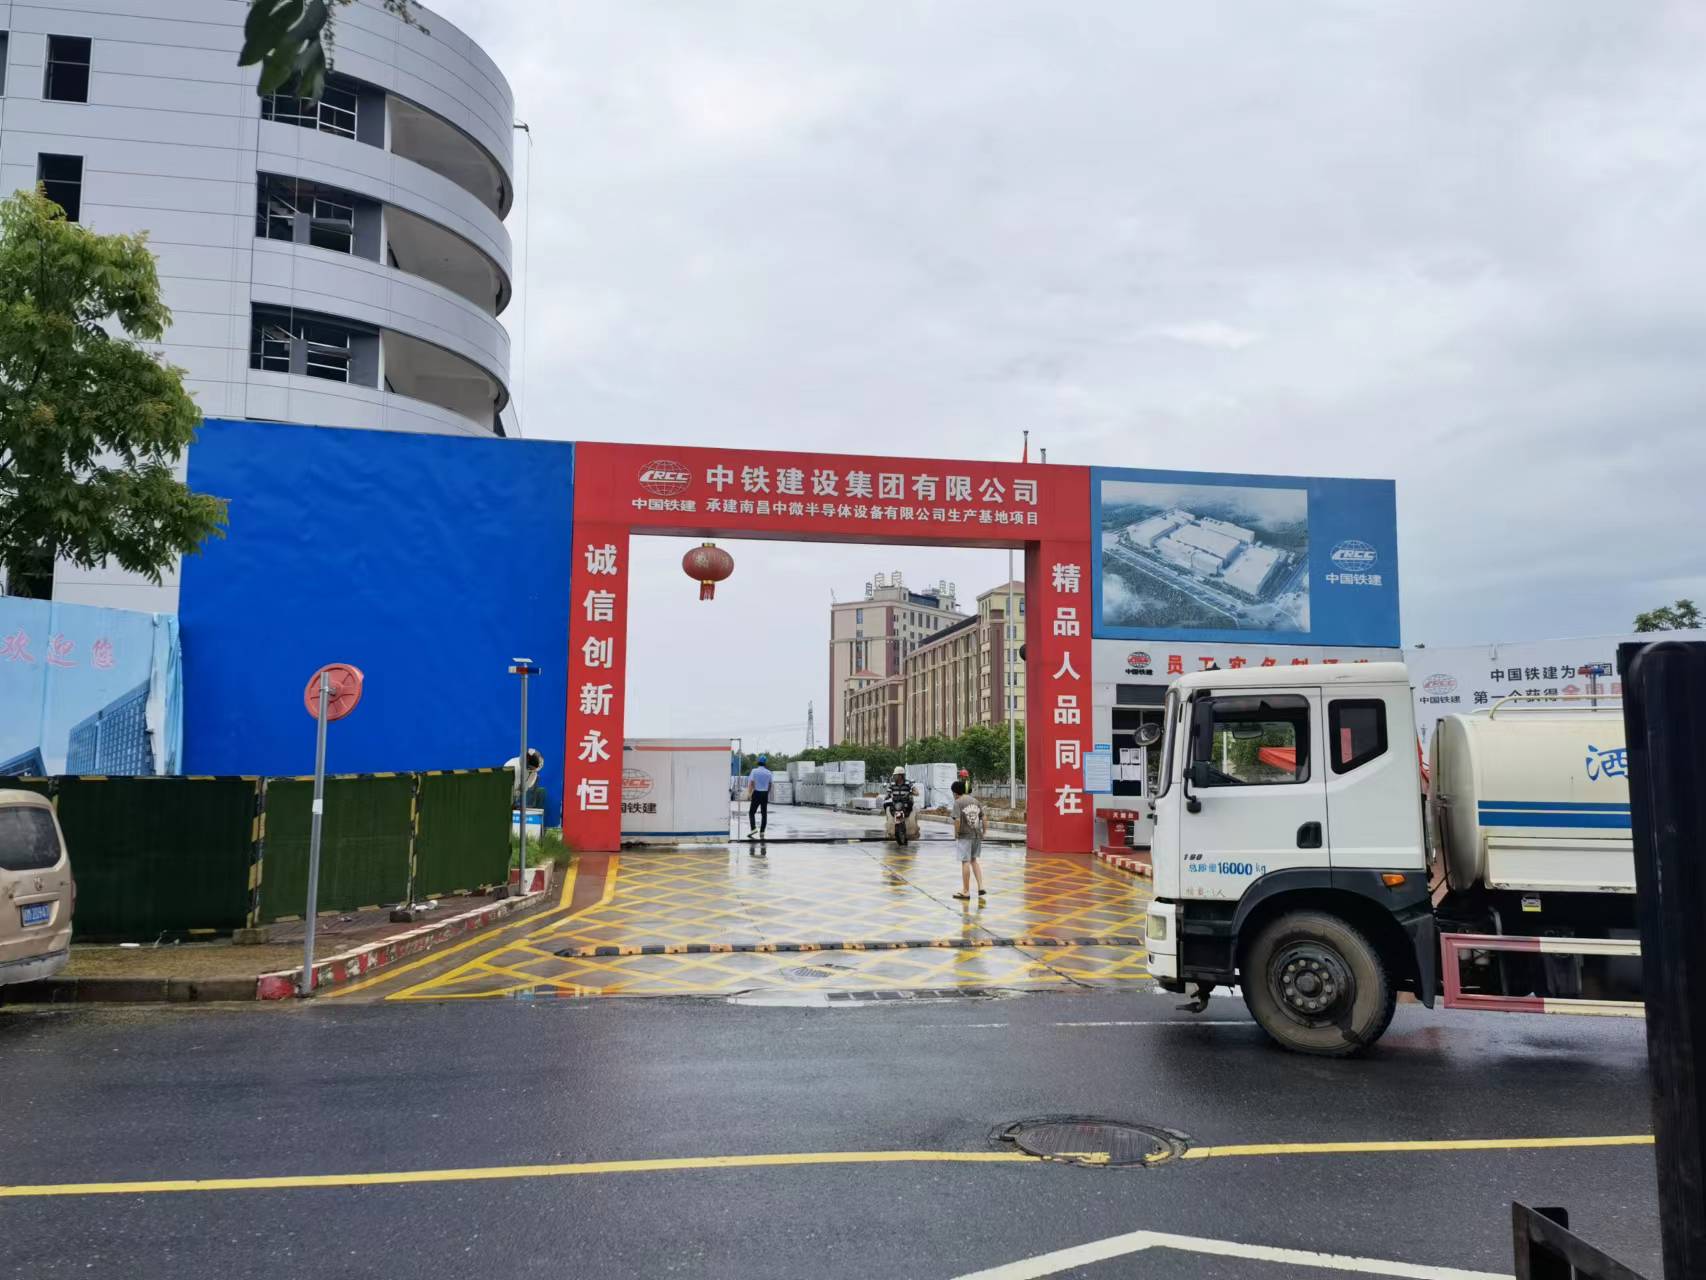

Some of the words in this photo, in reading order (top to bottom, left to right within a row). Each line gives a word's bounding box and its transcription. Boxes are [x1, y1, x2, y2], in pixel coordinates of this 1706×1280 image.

[706, 464, 1038, 506] 中铁建设集团有限公司
[632, 497, 696, 513] 中国铁建
[705, 498, 1038, 525] 承建南昌中微半导体设备有限公司生产基地项目
[1326, 572, 1383, 586] 中国铁建
[576, 543, 618, 811] 诚信创新永恒
[1490, 662, 1613, 682] 中国铁建为国
[1051, 563, 1084, 816] 精品人品同在
[1420, 695, 1461, 704] 中国铁建
[1218, 862, 1253, 875] 16000
